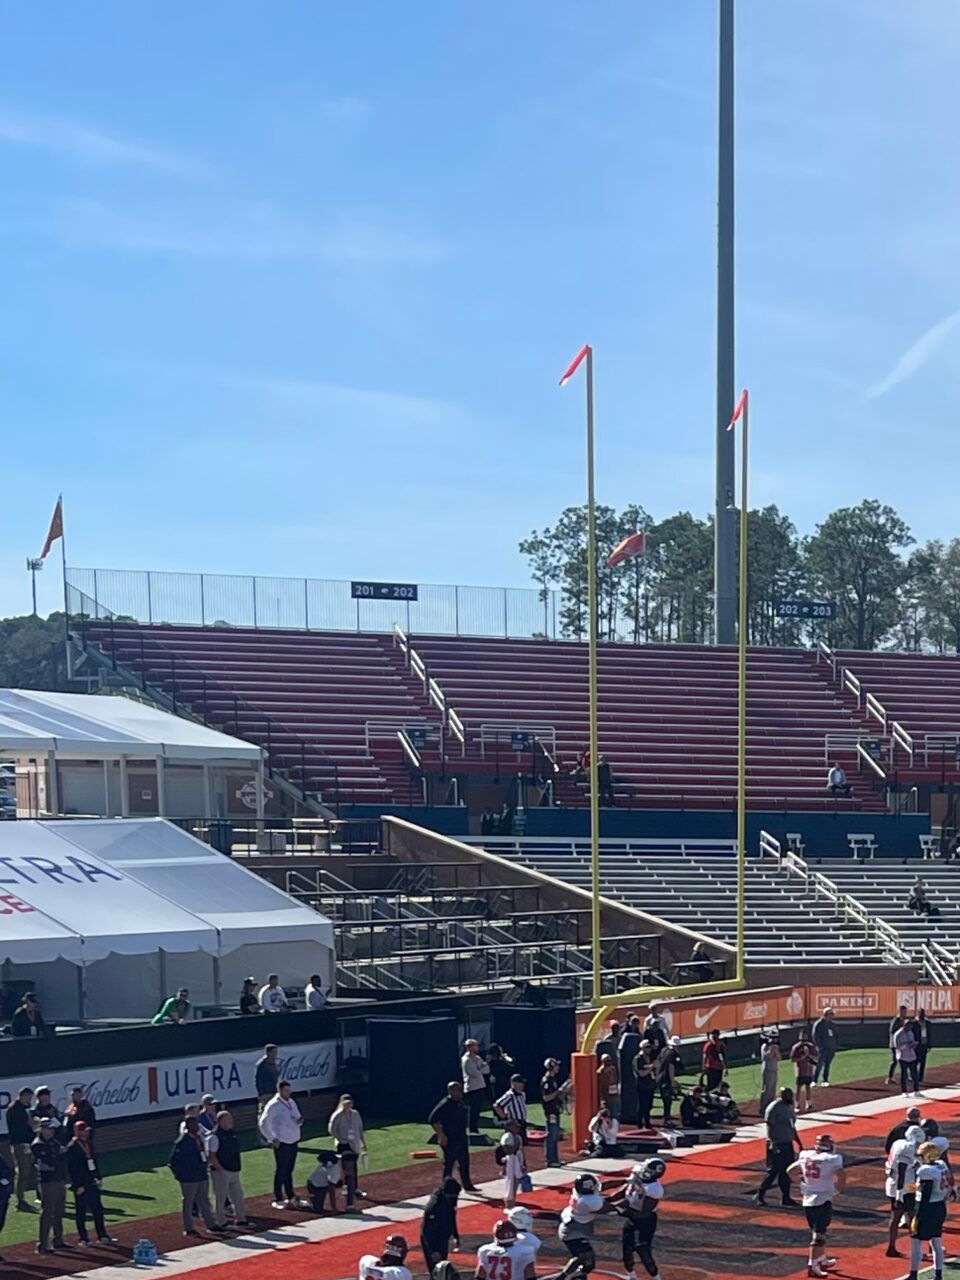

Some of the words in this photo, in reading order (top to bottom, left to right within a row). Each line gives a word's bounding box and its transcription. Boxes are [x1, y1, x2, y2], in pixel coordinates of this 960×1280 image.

[355, 585, 375, 596] 201
[393, 586, 414, 598] 202
[779, 604, 799, 615] 202
[812, 605, 832, 616] 203
[820, 997, 873, 1007] PANINI
[917, 989, 953, 1011] NFLPA
[164, 1062, 243, 1096] ULTRA
[487, 1255, 513, 1280] 73
